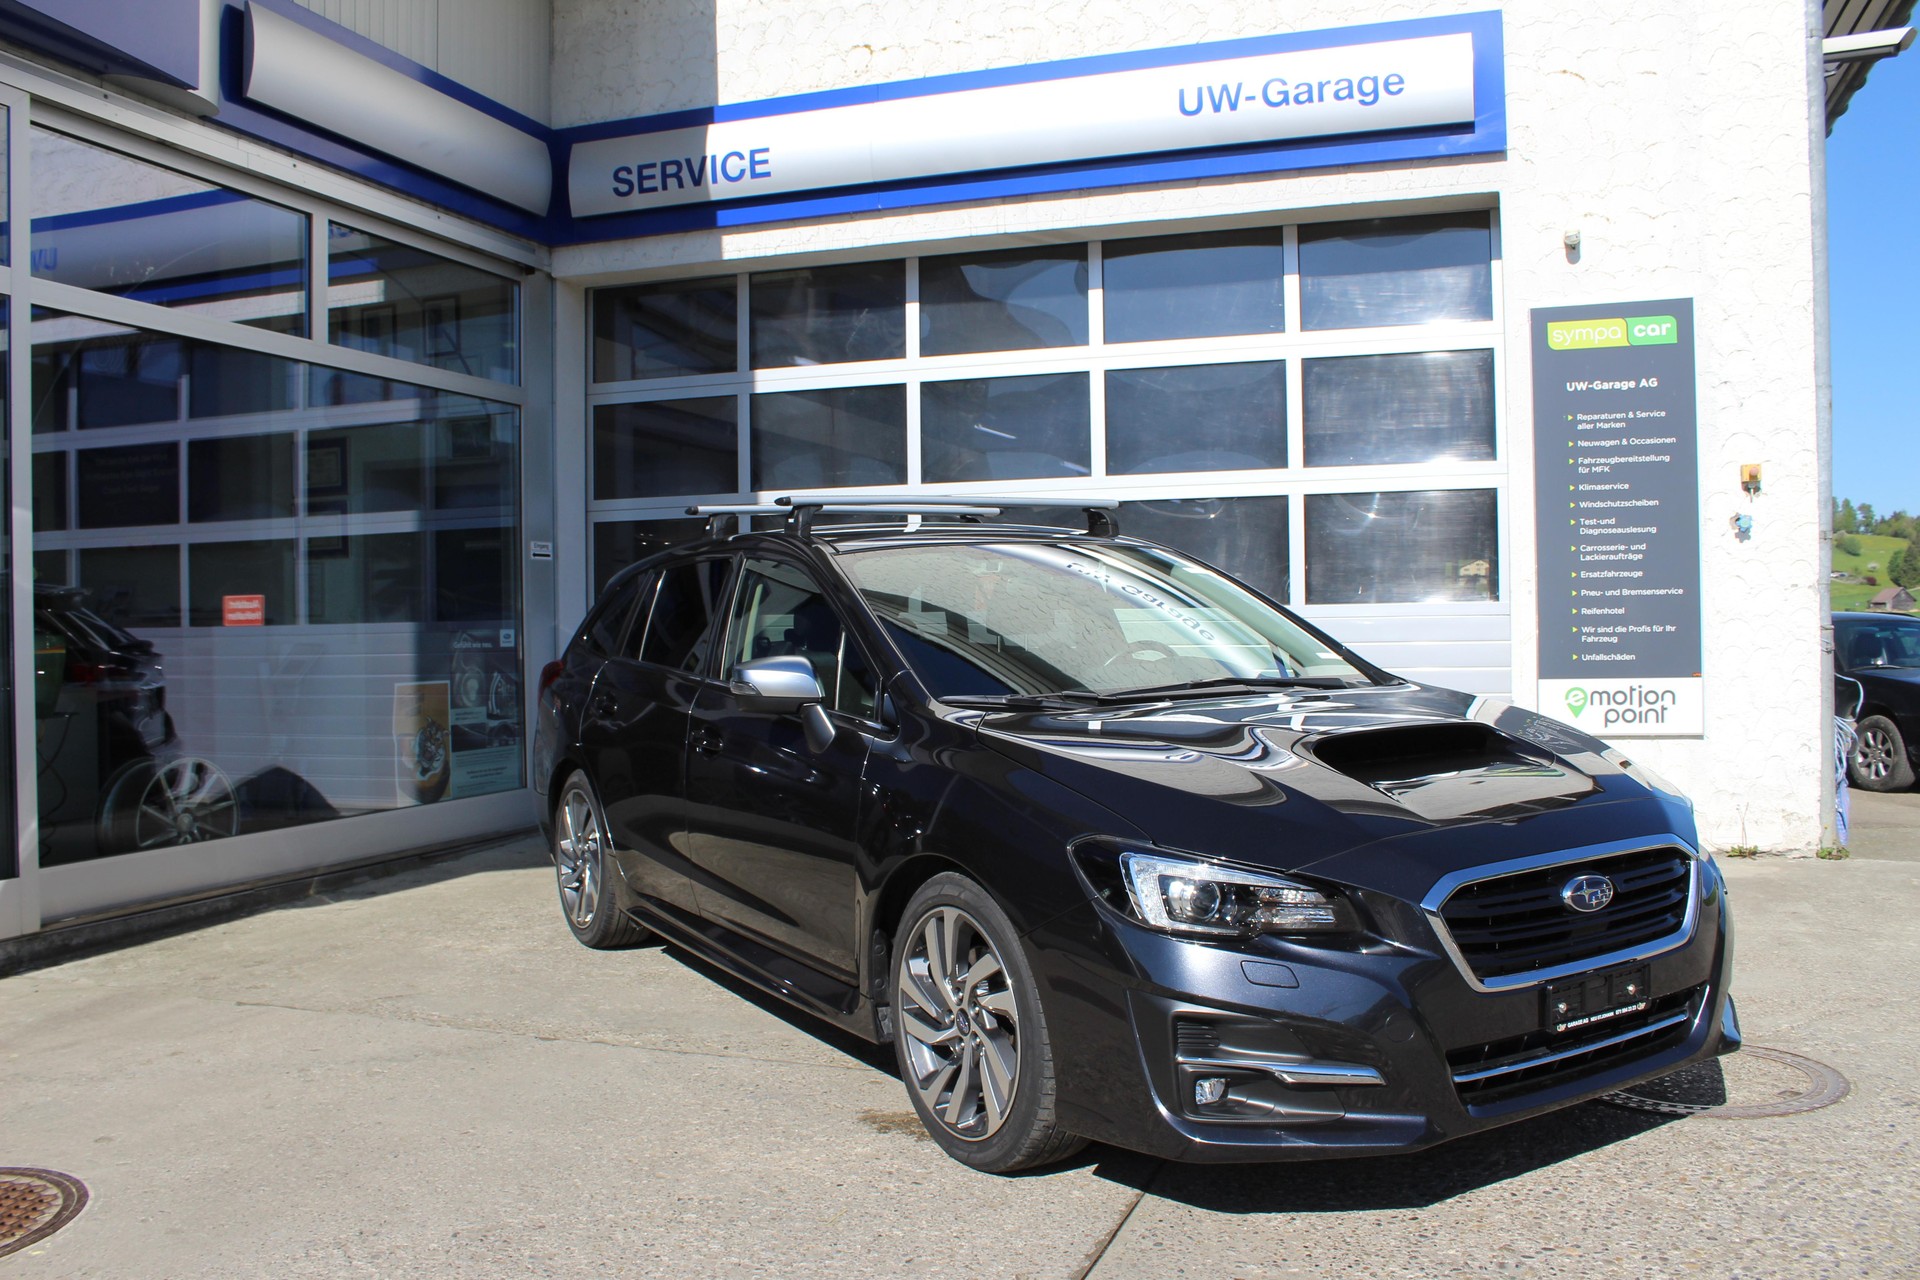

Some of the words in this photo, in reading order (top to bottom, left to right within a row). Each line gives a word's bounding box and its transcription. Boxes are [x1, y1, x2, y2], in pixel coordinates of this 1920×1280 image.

[1178, 73, 1405, 116] UW-Garage
[612, 147, 772, 197] SERVICE
[1552, 326, 1622, 346] sympa
[1633, 323, 1671, 338] car
[1566, 380, 1636, 392] UW-Garage
[1639, 378, 1658, 388] AG
[1577, 412, 1626, 421] Reparaturen
[1628, 411, 1634, 419] &
[1636, 410, 1666, 418] Service
[1577, 422, 1594, 430] aller
[1596, 421, 1626, 429] Marken
[1577, 439, 1620, 448] Neuwagen
[1621, 438, 1628, 446] &
[1629, 436, 1676, 445] Occasionen
[1578, 454, 1670, 465] Fahrzeugbereitstellung
[1578, 466, 1590, 474] für
[1592, 465, 1610, 473] MFK
[1579, 482, 1630, 491] Klimaservice
[1579, 499, 1659, 508] Windschutzscheiben
[1580, 517, 1616, 526] Test-und
[1580, 526, 1657, 536] Diagnoseauslesung
[1580, 544, 1628, 552] Carrosserie-
[1580, 552, 1644, 561] Lackieraufträge
[1580, 570, 1643, 579] Ersatzfahrzeuge
[1581, 589, 1604, 597] Pneu-
[1605, 588, 1620, 596] und
[1622, 587, 1684, 596] Bremsenservice
[1581, 607, 1625, 615] Reifenhotel
[1581, 626, 1596, 634] Wir
[1597, 625, 1613, 633] sind
[1615, 625, 1627, 633] die
[1628, 625, 1651, 633] Profis
[1652, 624, 1664, 632] für
[1665, 624, 1677, 632] Ihr
[1581, 635, 1618, 644] Fahrzeug
[1581, 653, 1636, 661] Unfallschäden
[1604, 705, 1668, 728] point
